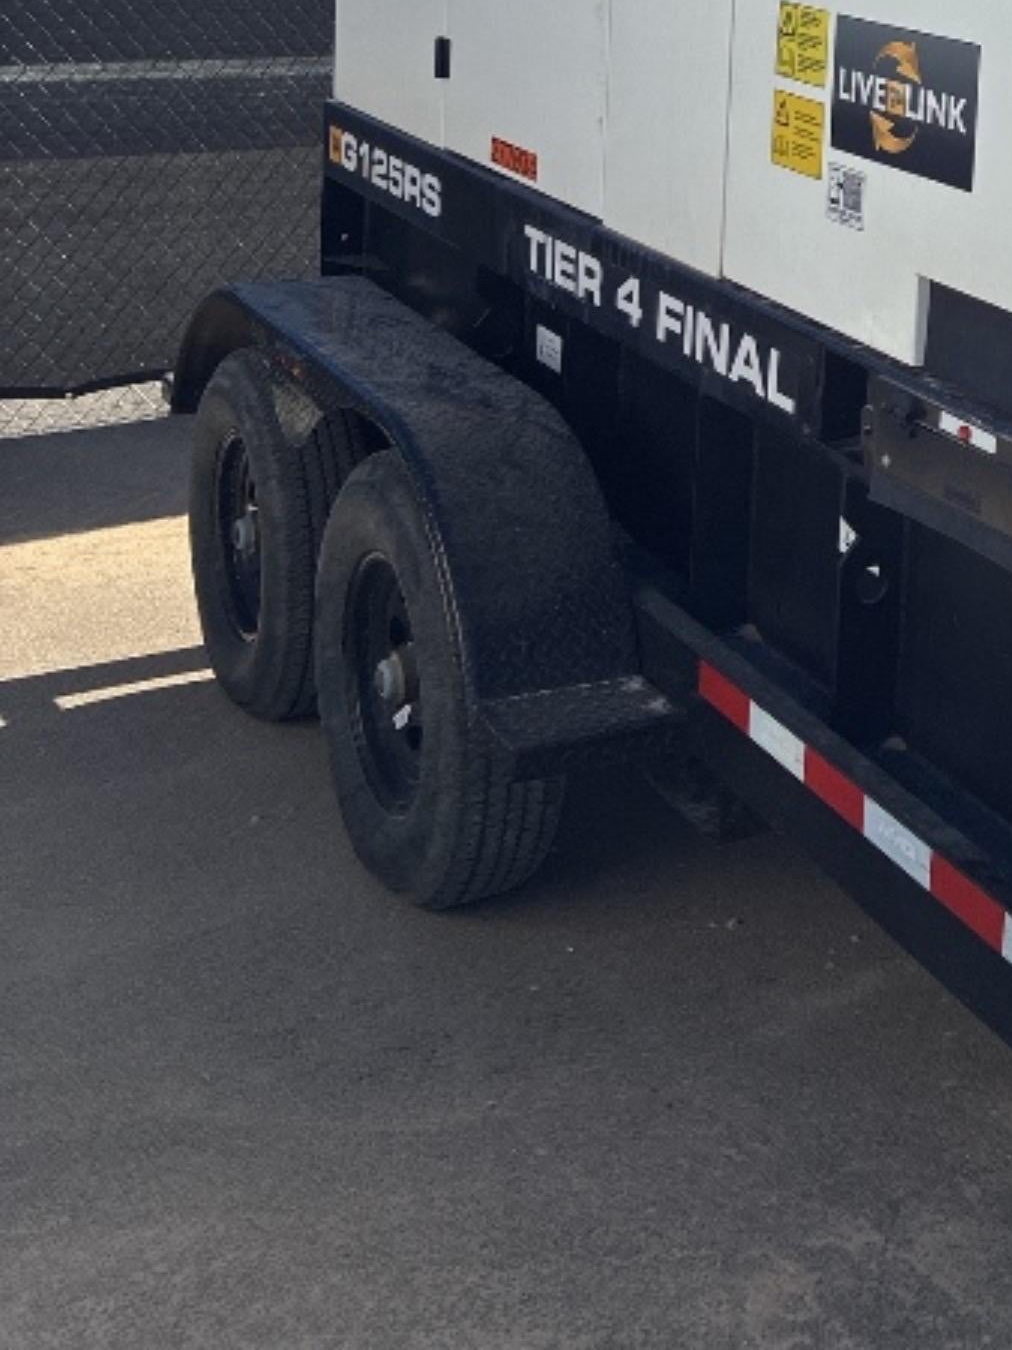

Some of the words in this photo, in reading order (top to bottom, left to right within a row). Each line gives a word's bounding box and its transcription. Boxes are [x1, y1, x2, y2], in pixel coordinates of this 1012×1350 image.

[341, 130, 442, 218] G125RS
[523, 223, 603, 307] TIER
[614, 276, 643, 328] 4
[656, 290, 797, 415] FINAL
